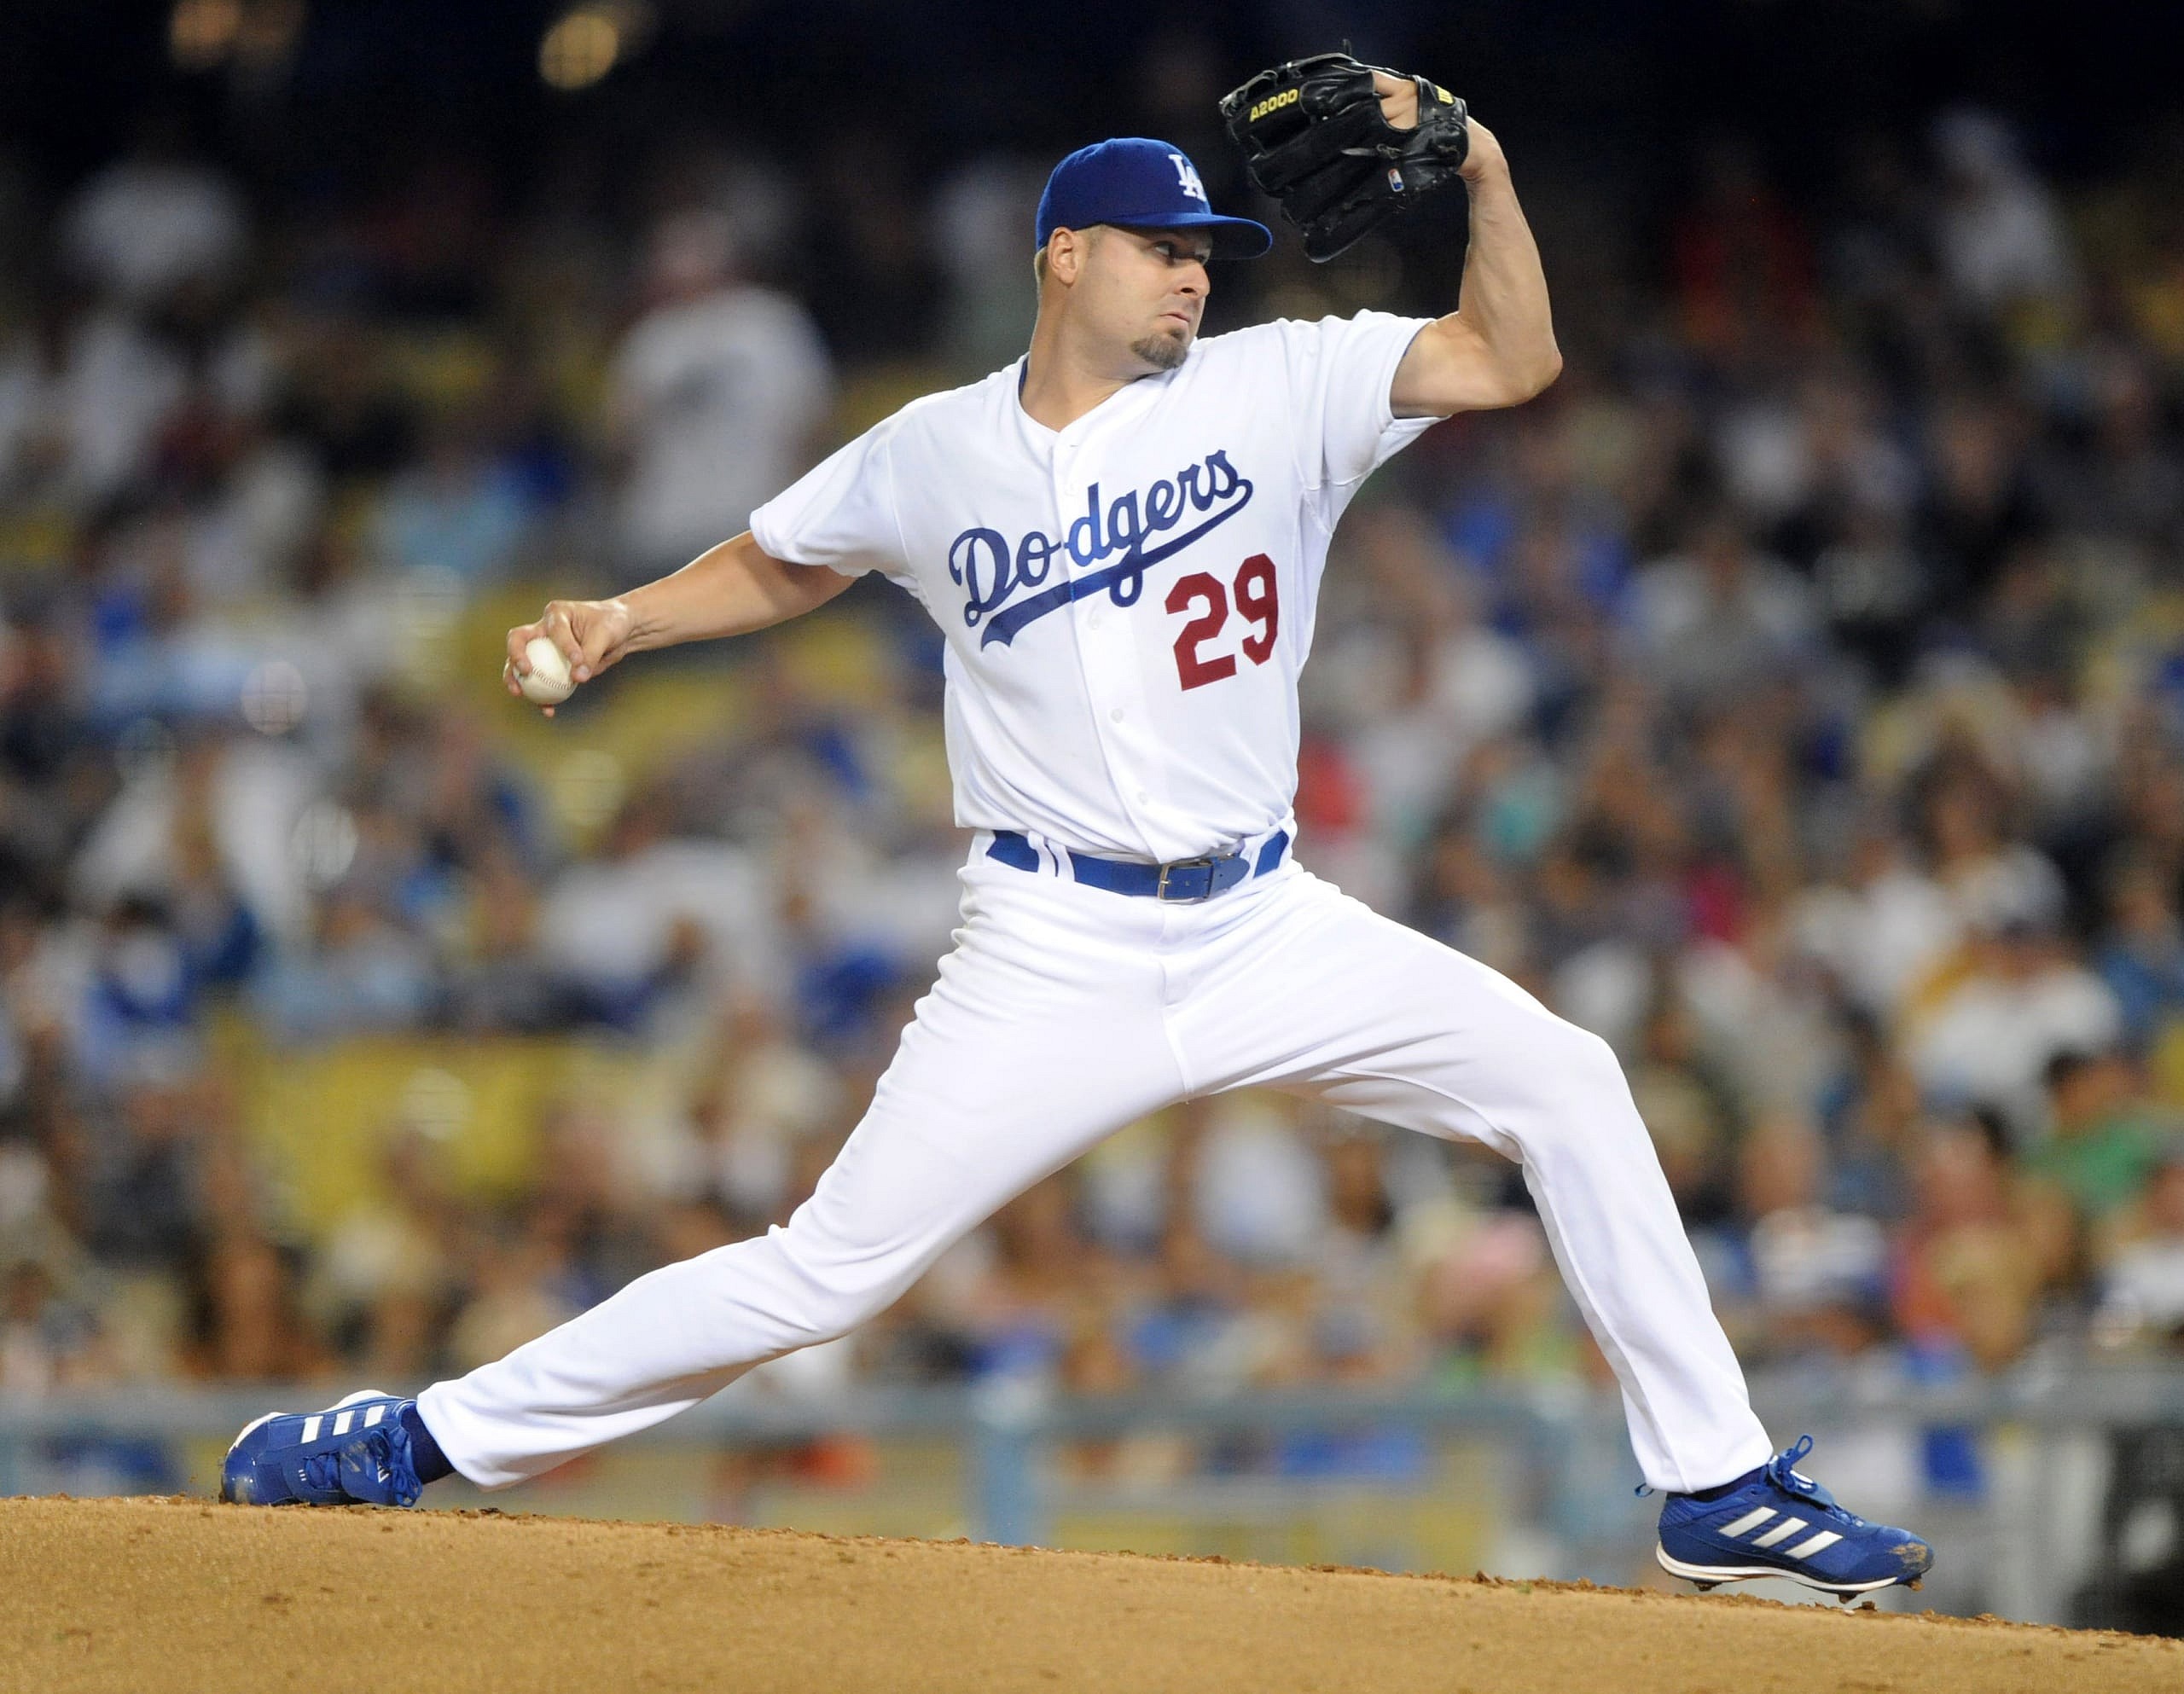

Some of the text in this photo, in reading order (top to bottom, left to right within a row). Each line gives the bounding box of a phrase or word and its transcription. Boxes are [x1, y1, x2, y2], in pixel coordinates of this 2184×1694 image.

[1249, 89, 1298, 123] A2000
[1168, 154, 1207, 202] LA
[949, 450, 1253, 631] Dodgers
[1165, 553, 1279, 691] 29
